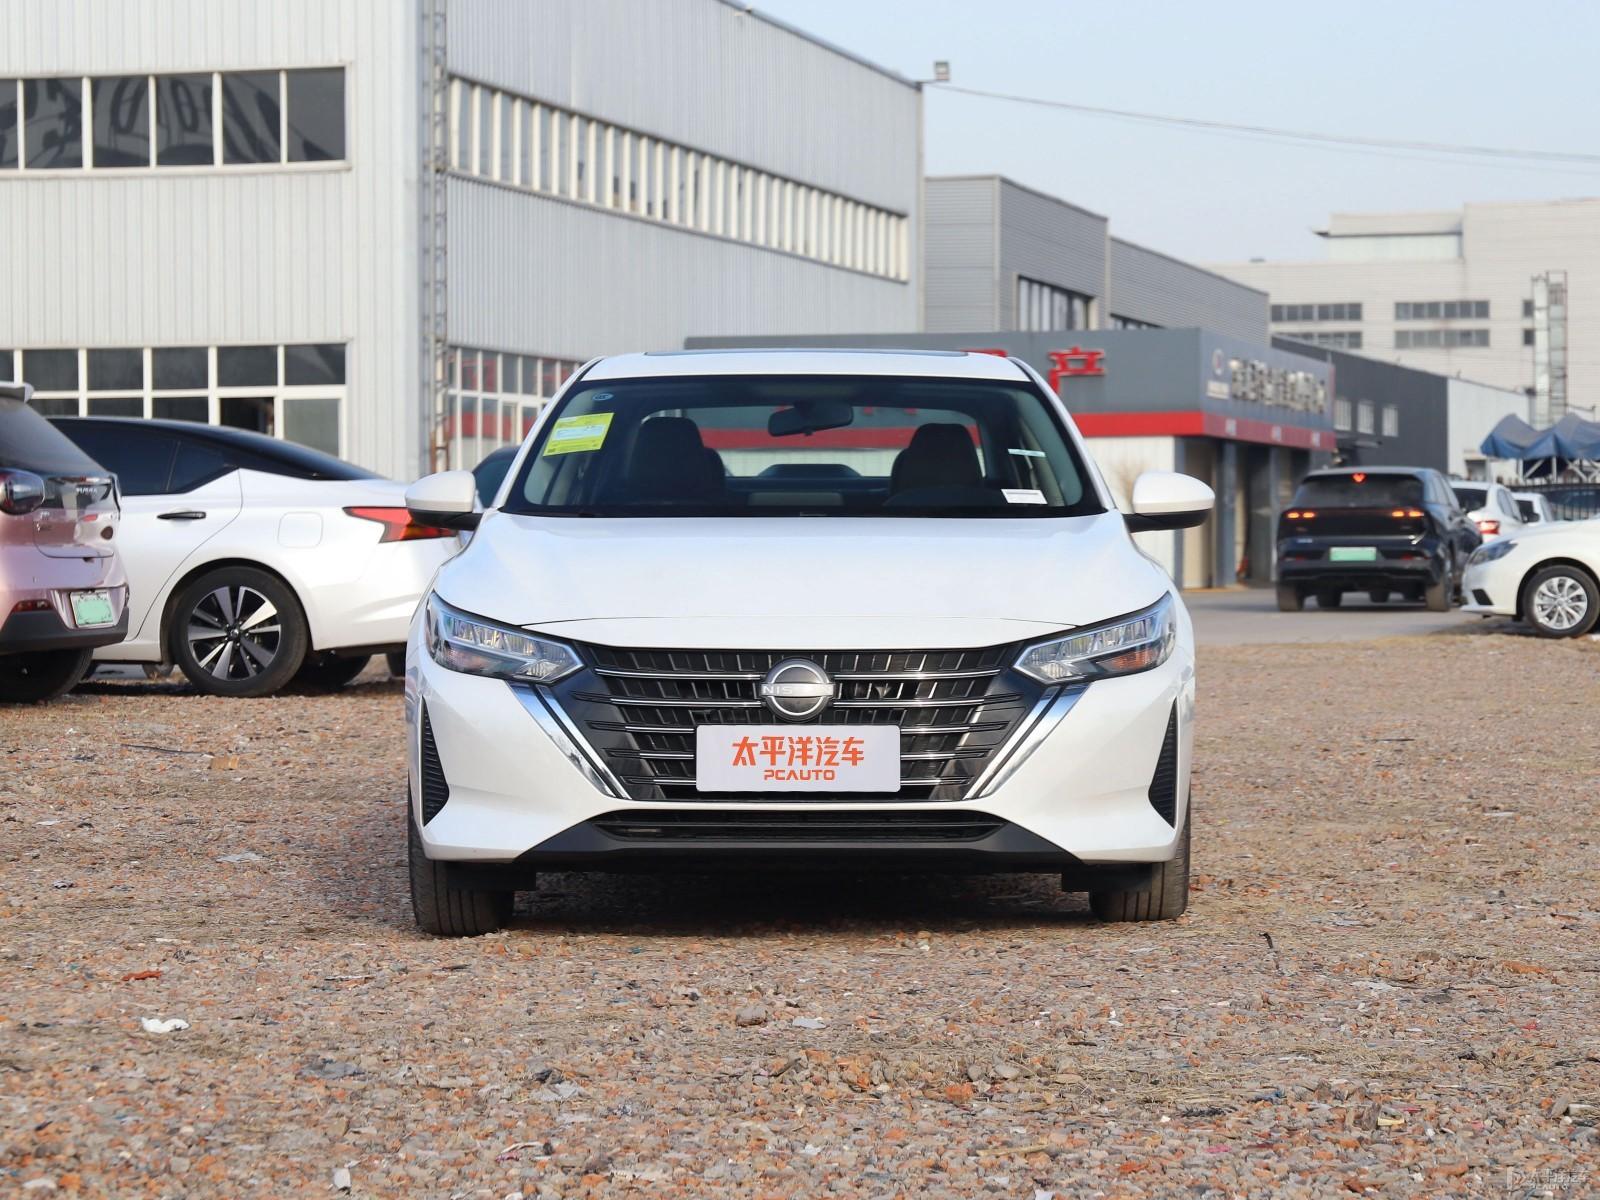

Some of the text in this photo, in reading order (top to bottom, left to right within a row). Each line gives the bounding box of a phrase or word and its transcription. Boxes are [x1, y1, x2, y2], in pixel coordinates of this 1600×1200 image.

[762, 685, 831, 695] NIS
[732, 736, 864, 766] 太平洋汽车
[764, 769, 836, 781] PCAUTO
